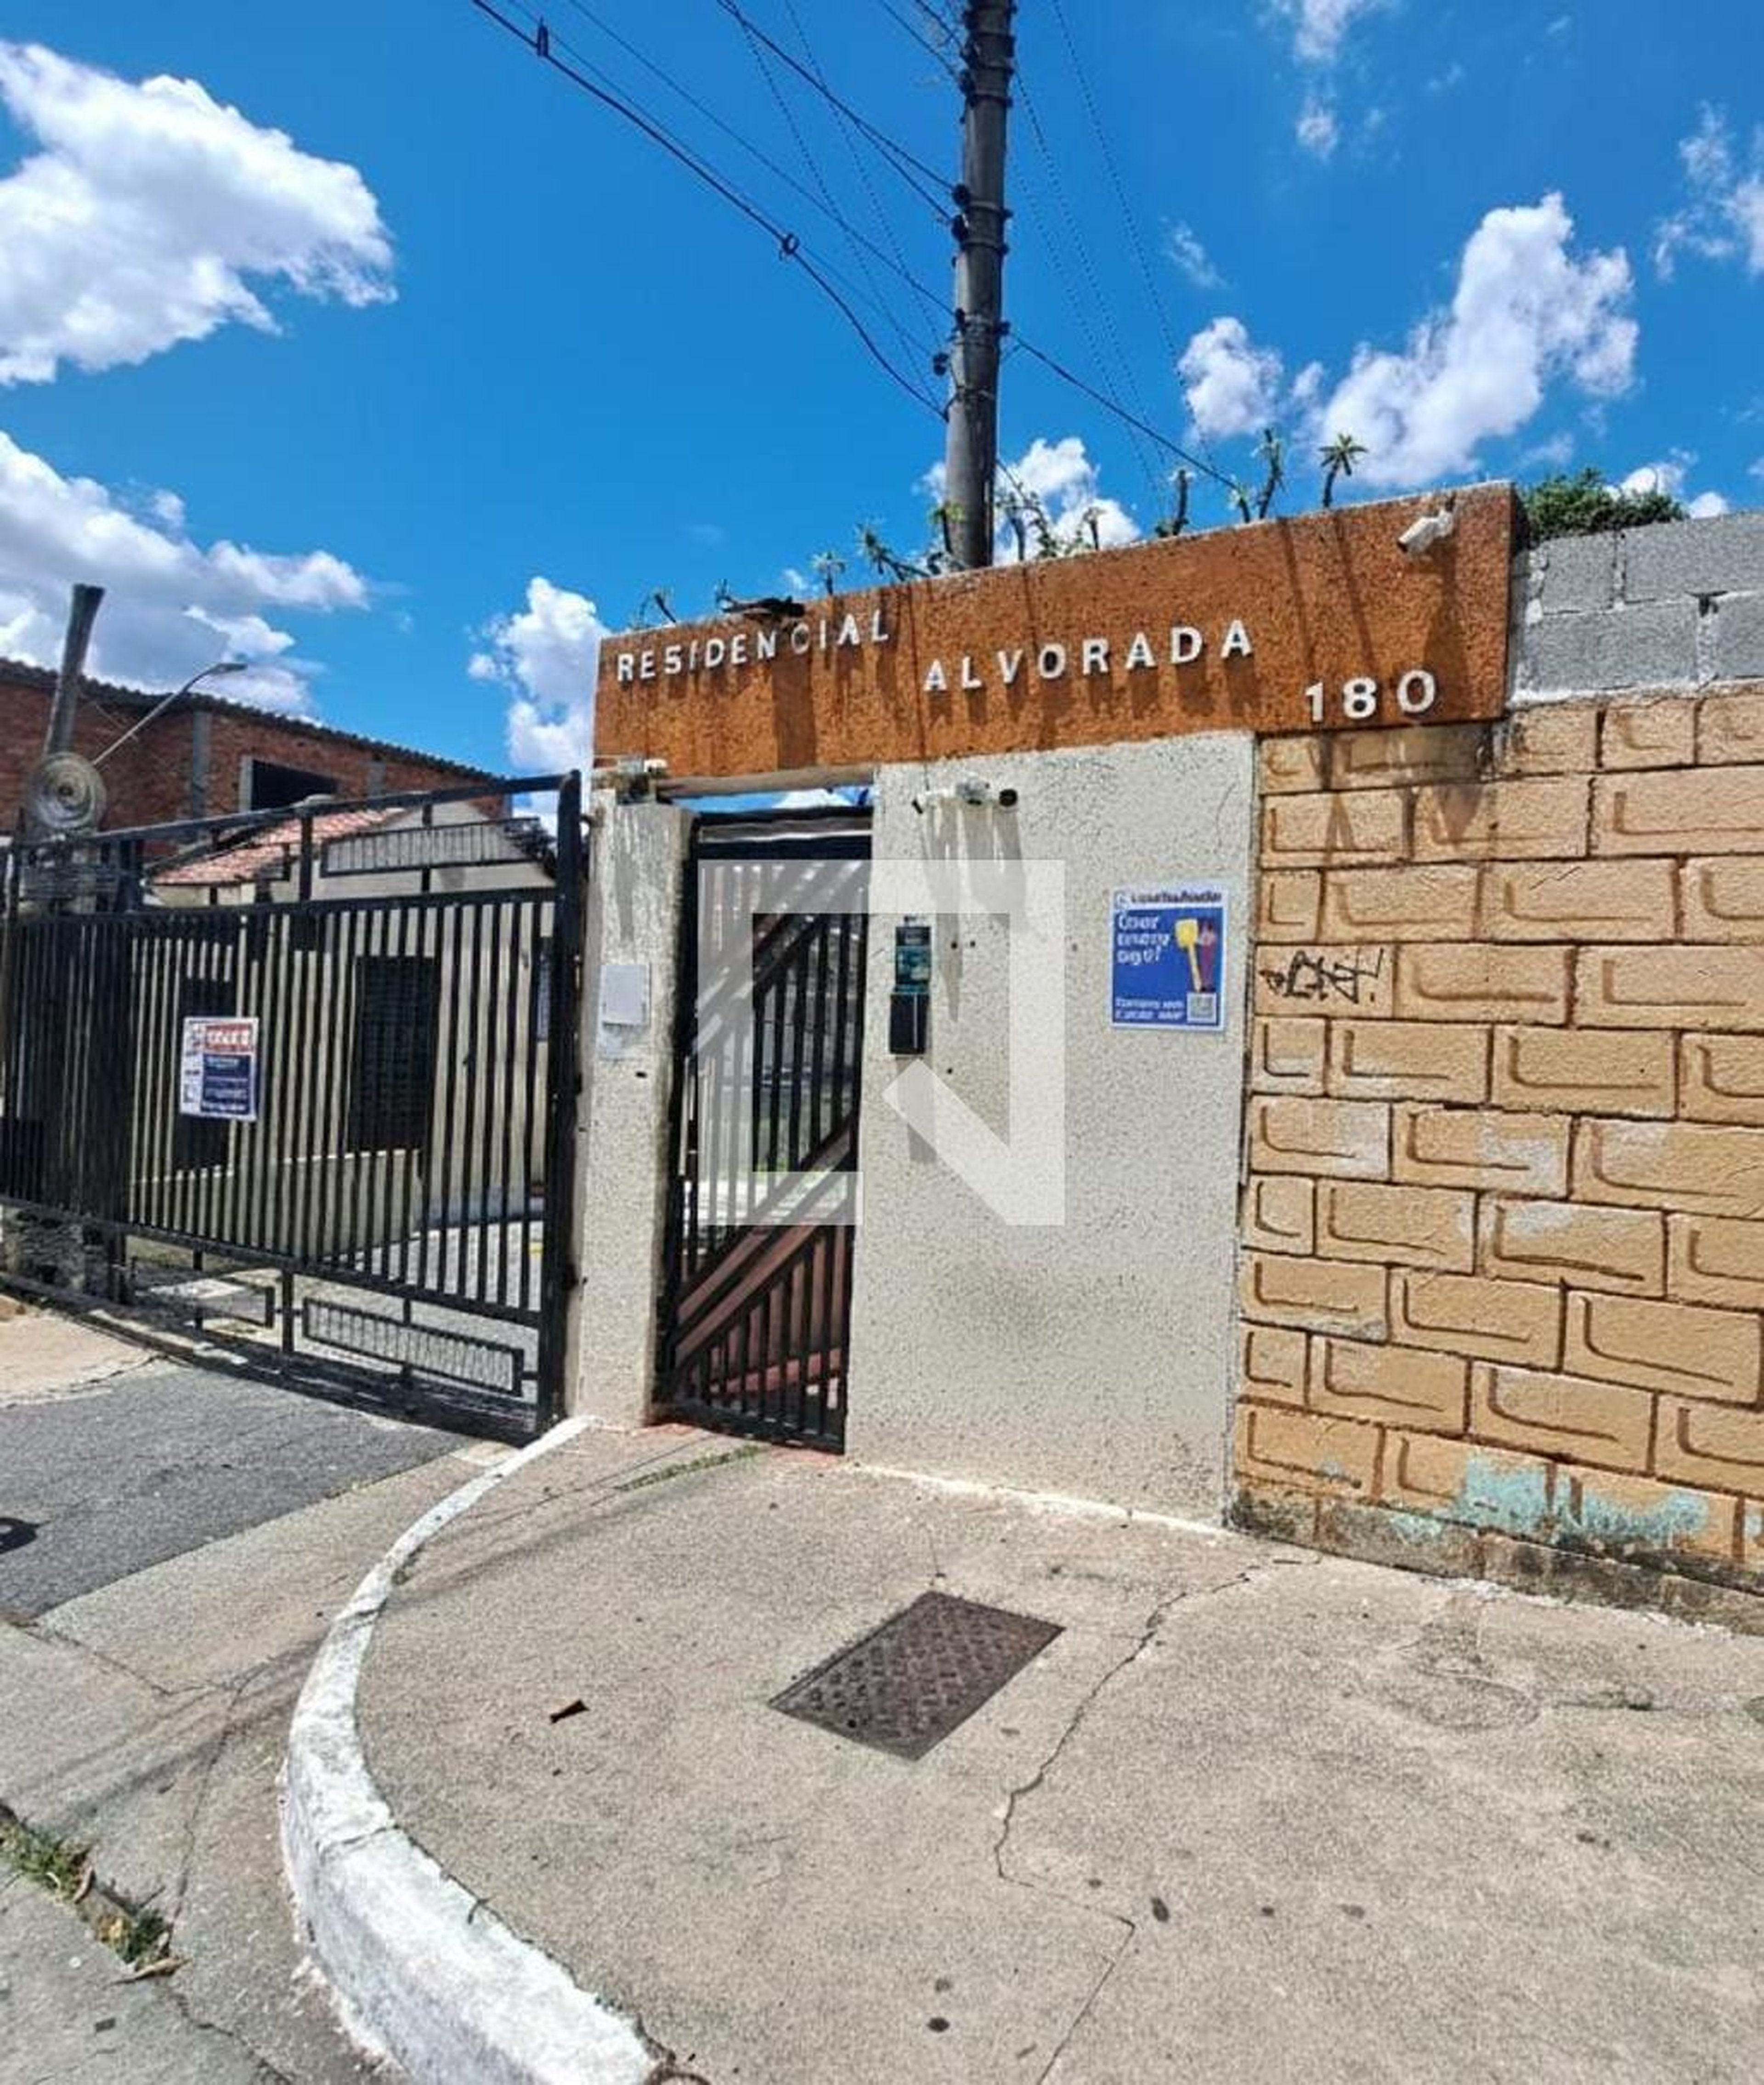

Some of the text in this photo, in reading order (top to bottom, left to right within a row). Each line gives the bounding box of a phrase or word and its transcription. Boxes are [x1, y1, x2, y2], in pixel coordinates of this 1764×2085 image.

[618, 610, 1254, 691] RESIDENCIAL ALVORADA
[1305, 669, 1436, 722] 180
